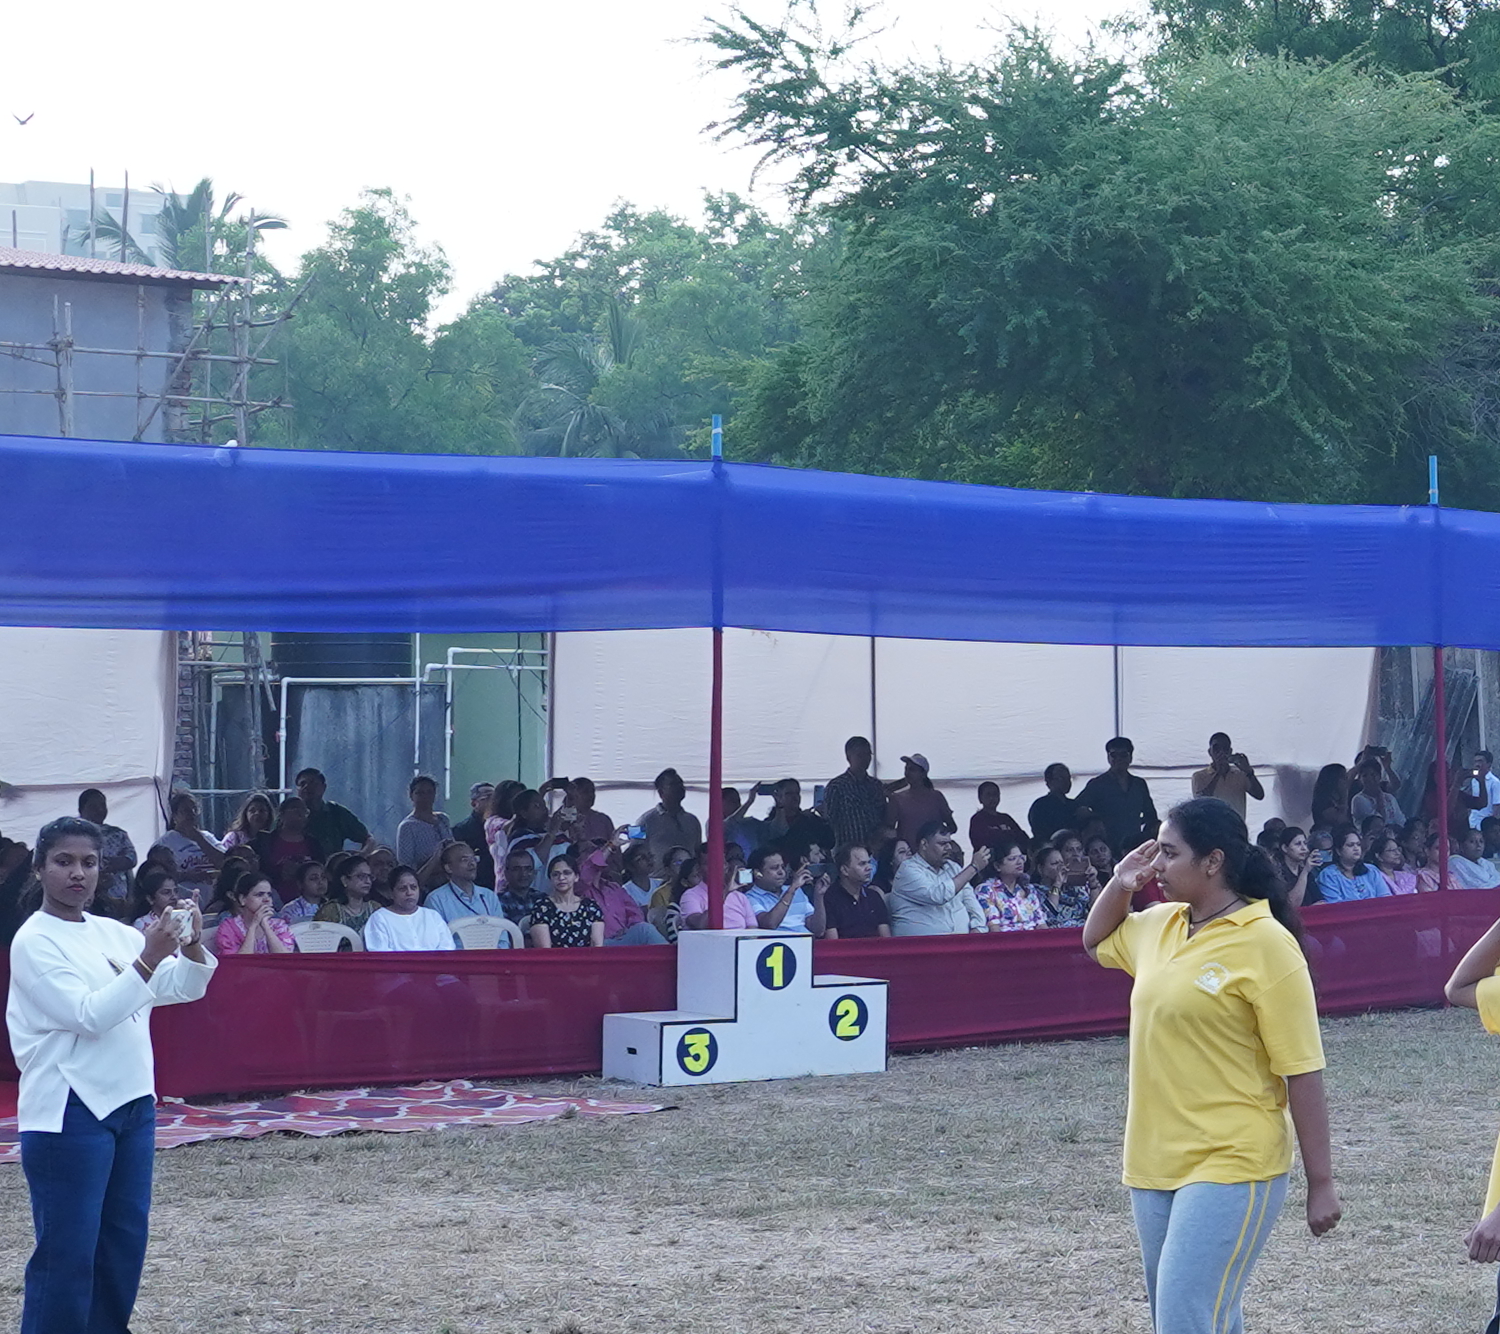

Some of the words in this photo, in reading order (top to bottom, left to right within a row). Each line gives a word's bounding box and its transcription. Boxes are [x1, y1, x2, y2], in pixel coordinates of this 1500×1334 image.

[766, 946, 784, 987] 1
[836, 999, 860, 1037] 2
[684, 1034, 710, 1073] 3
